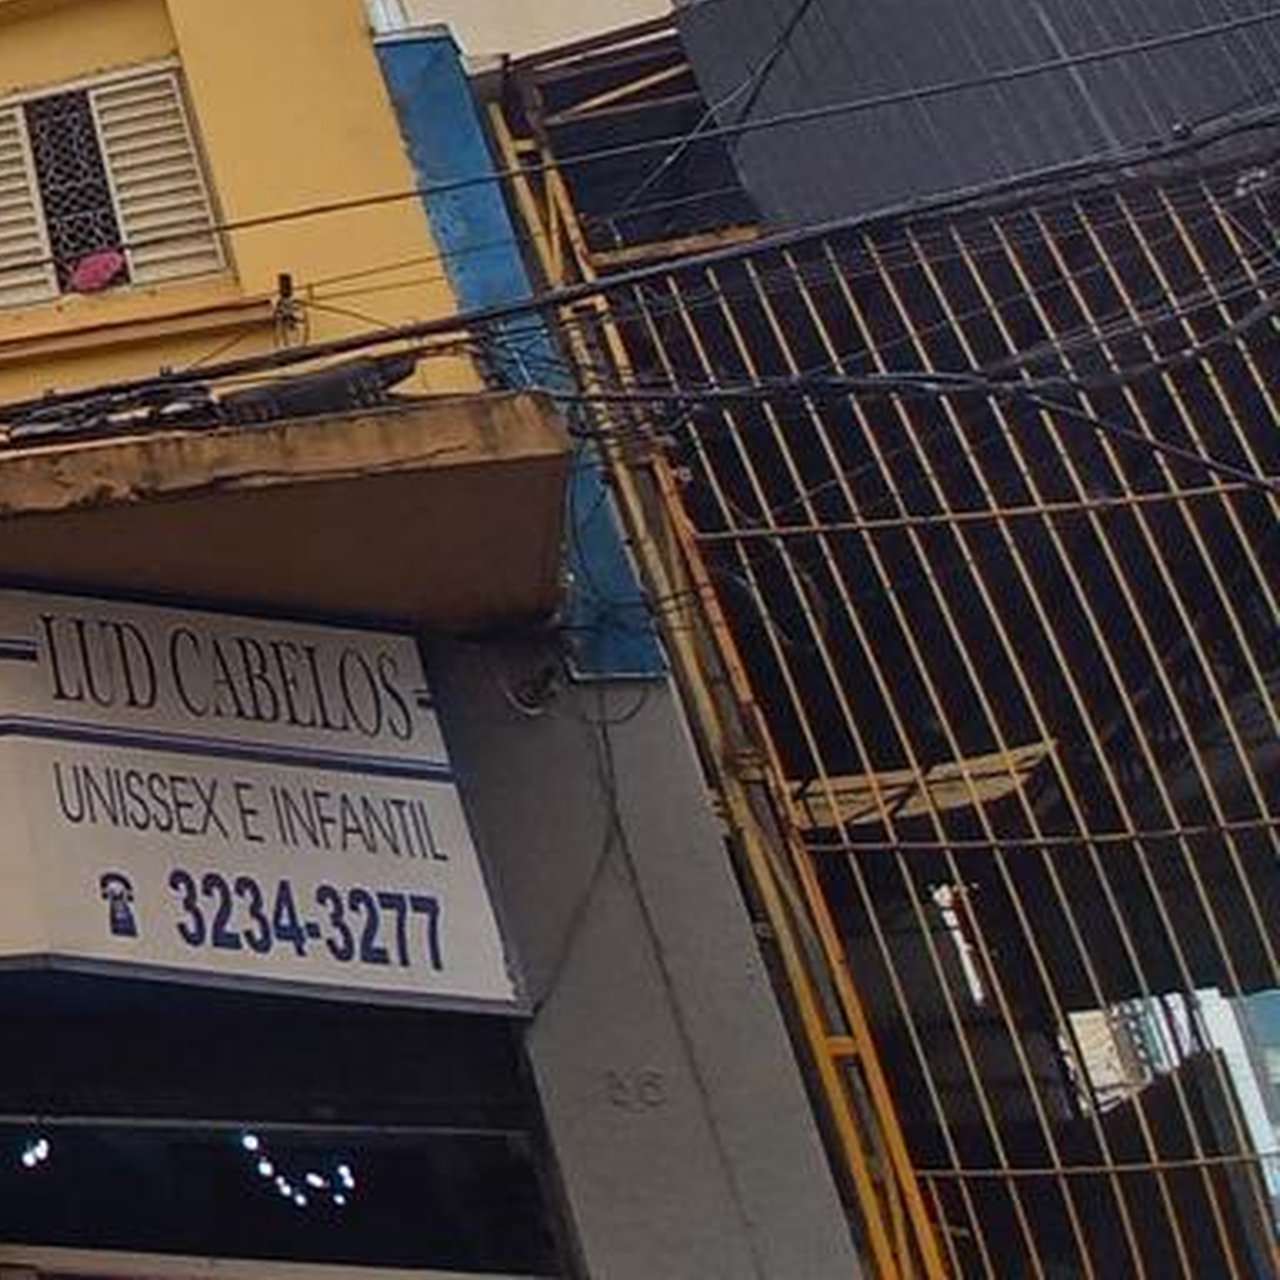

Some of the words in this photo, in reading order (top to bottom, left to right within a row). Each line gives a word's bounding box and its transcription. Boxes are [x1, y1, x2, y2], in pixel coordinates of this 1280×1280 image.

[40, 615, 158, 710] LUD
[168, 627, 414, 741] CABELOS
[53, 761, 229, 839] UNISSEX
[234, 782, 264, 844] E
[270, 783, 449, 862] INFANTIL
[168, 868, 443, 972] 3234-3277
